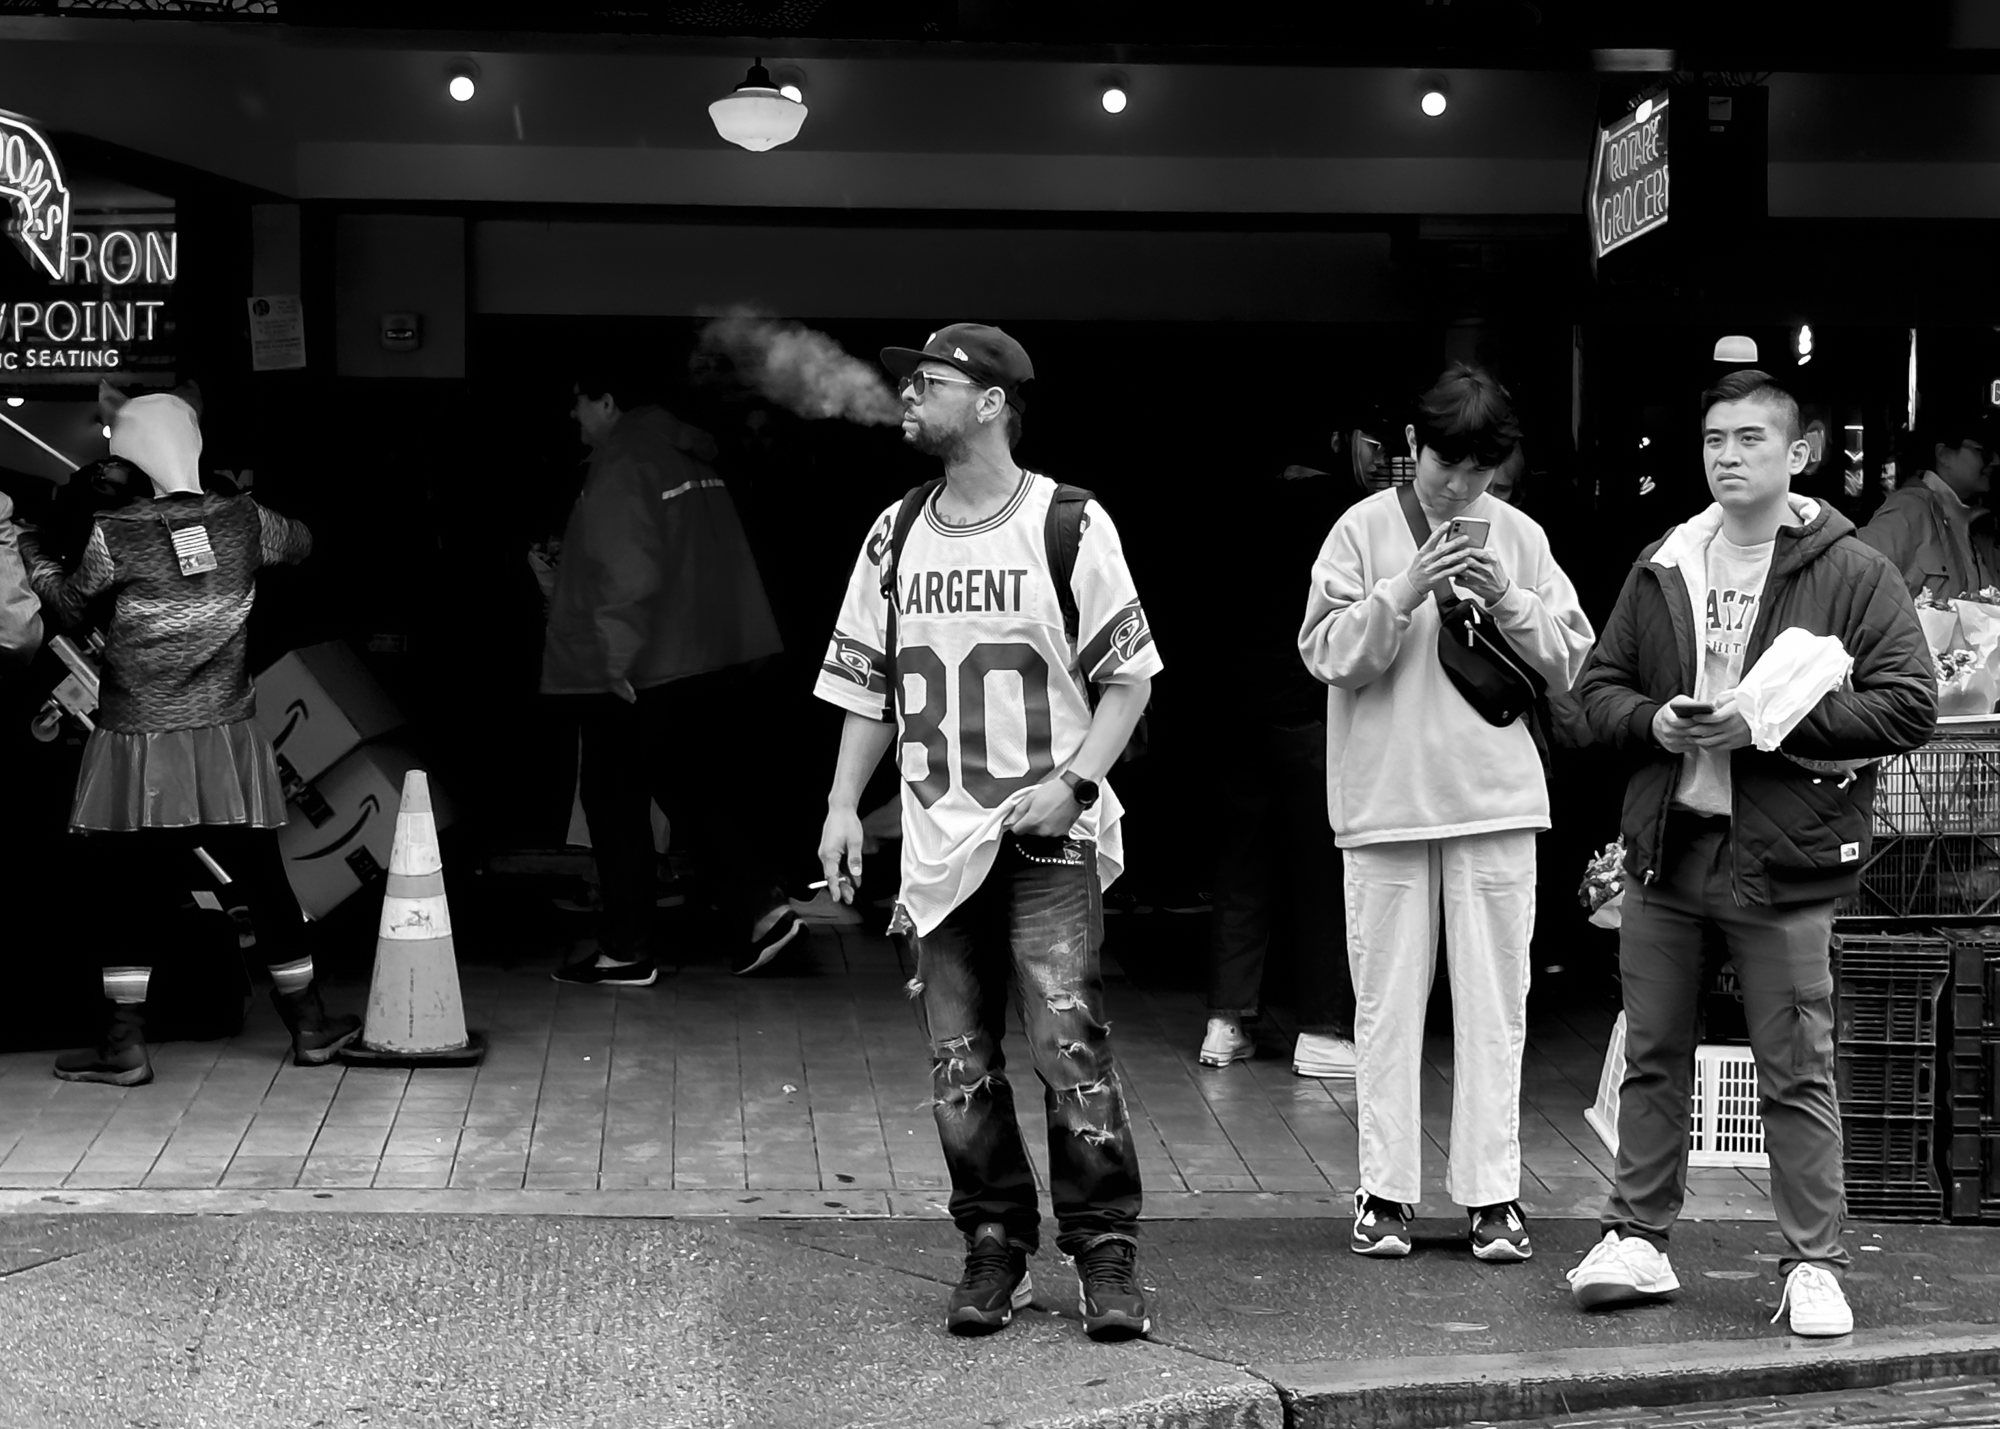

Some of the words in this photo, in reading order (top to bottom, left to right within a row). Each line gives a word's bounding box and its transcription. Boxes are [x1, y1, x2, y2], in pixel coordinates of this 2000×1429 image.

[26, 348, 120, 369] SEATING
[898, 568, 1028, 616] ARGENT
[896, 642, 1056, 810] 80
